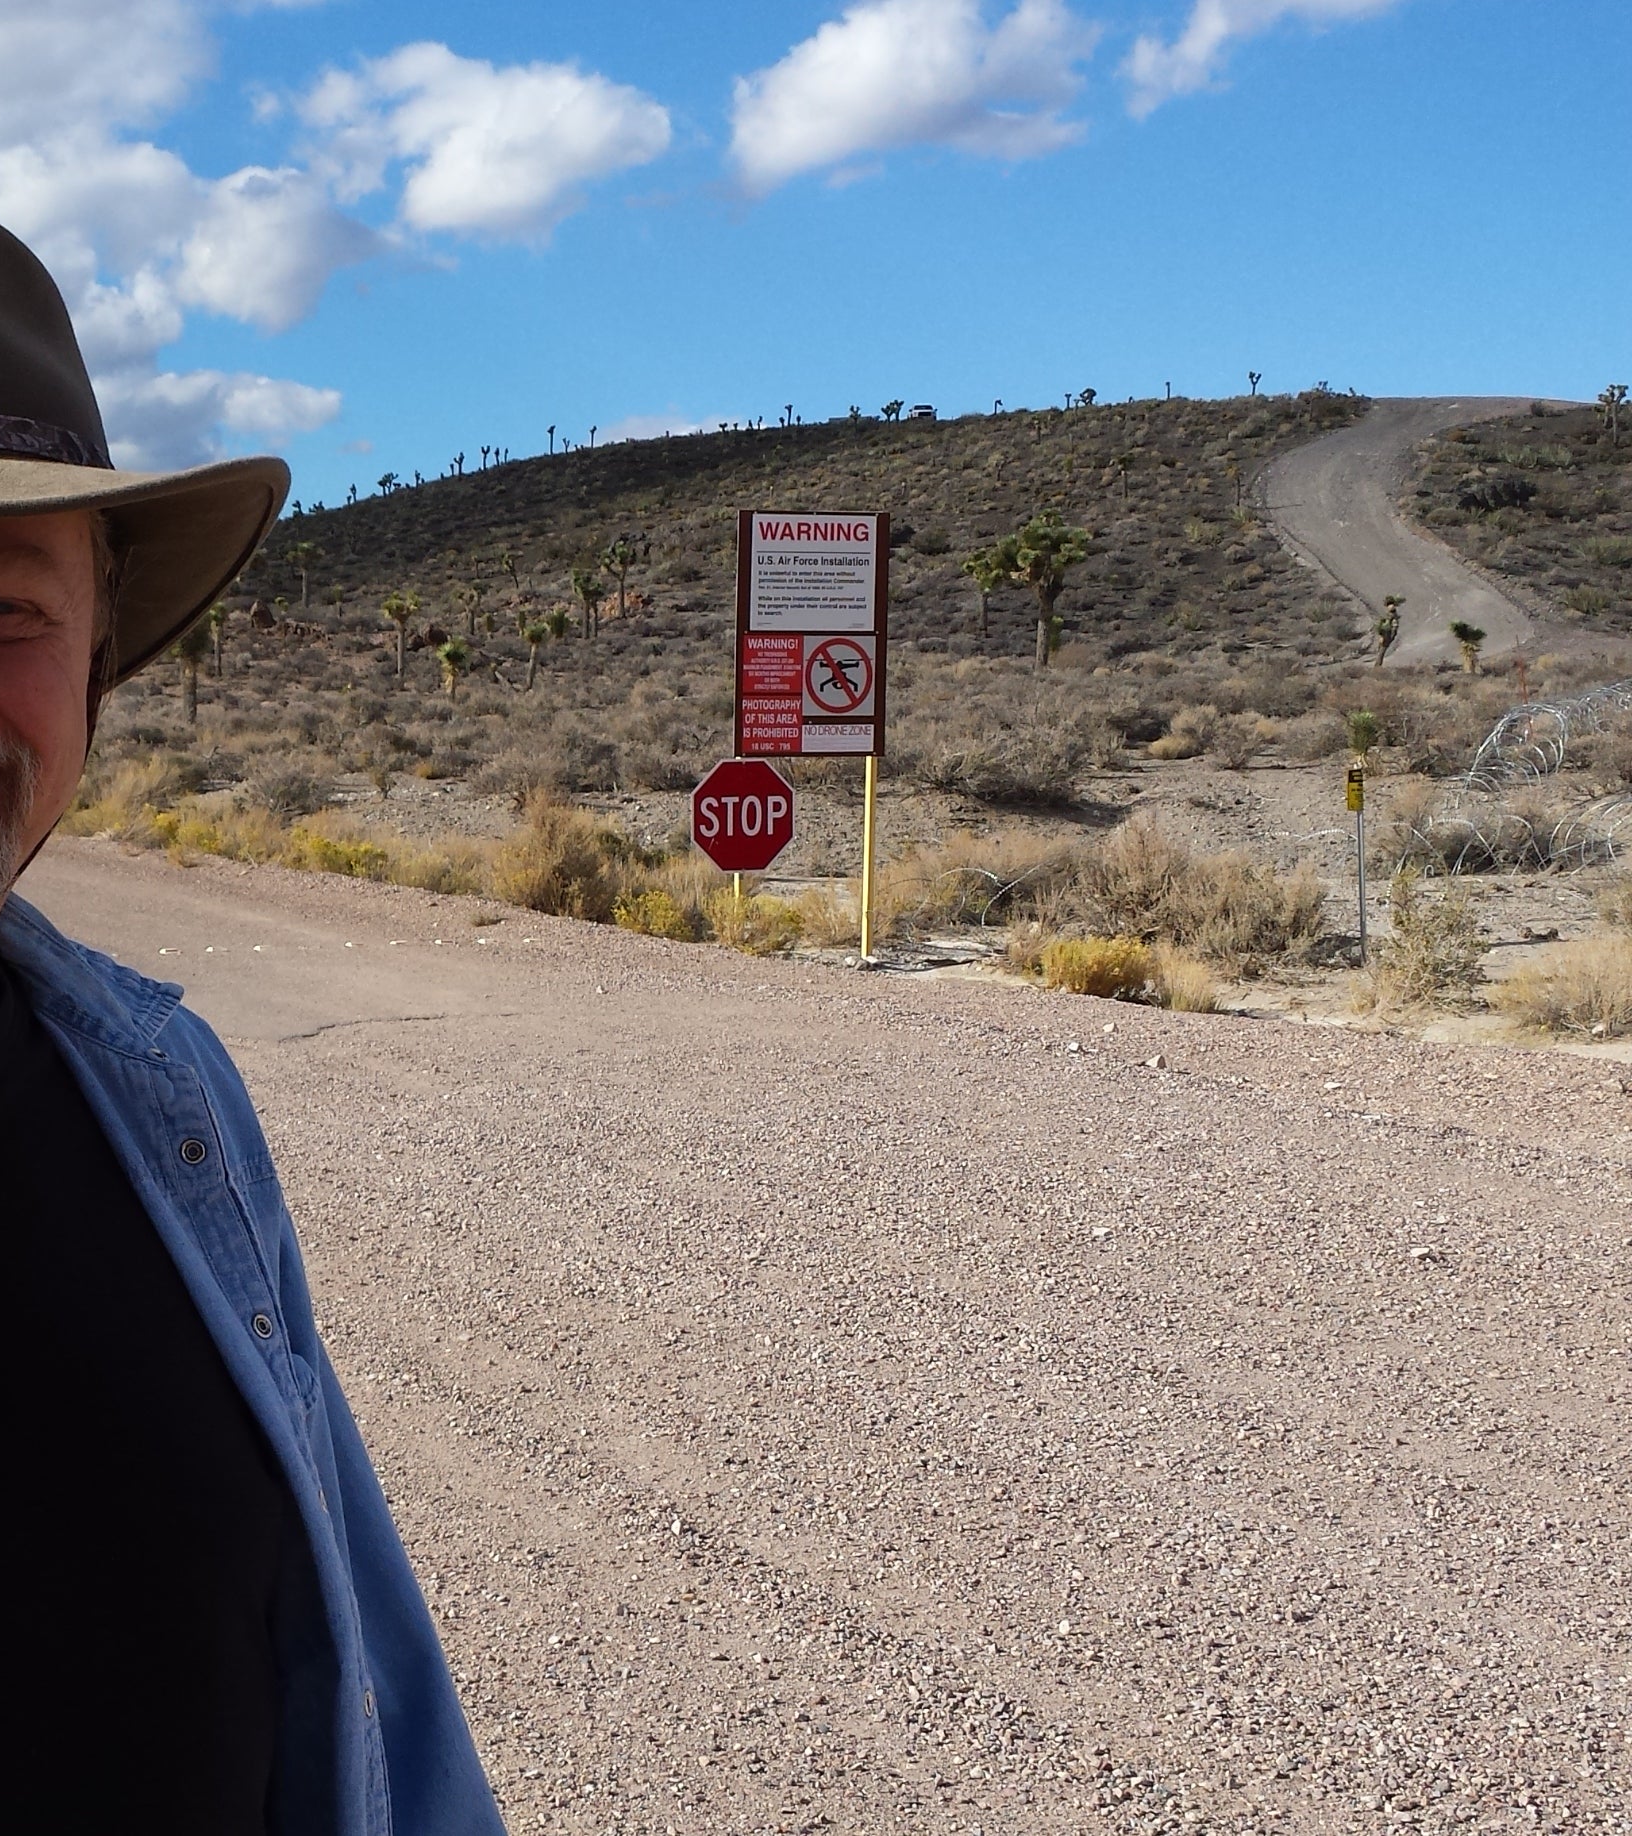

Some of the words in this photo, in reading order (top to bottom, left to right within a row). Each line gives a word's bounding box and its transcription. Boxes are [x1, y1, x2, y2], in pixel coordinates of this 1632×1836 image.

[758, 521, 870, 542] WARNING
[757, 556, 776, 566] U.S.
[778, 556, 791, 566] Air
[793, 556, 819, 566] Force
[821, 556, 870, 567] Installation
[748, 638, 799, 650] WARNING!
[742, 699, 801, 711] PHOTOGRAPHY
[745, 714, 756, 724] OF
[758, 714, 774, 724] THIS
[776, 714, 798, 724] AREA
[743, 728, 751, 738] IS
[752, 728, 799, 738] PROHIBITED
[804, 725, 817, 736] NO
[818, 725, 847, 736] DRONE
[848, 725, 872, 736] ZONE
[699, 795, 788, 838] STOP
